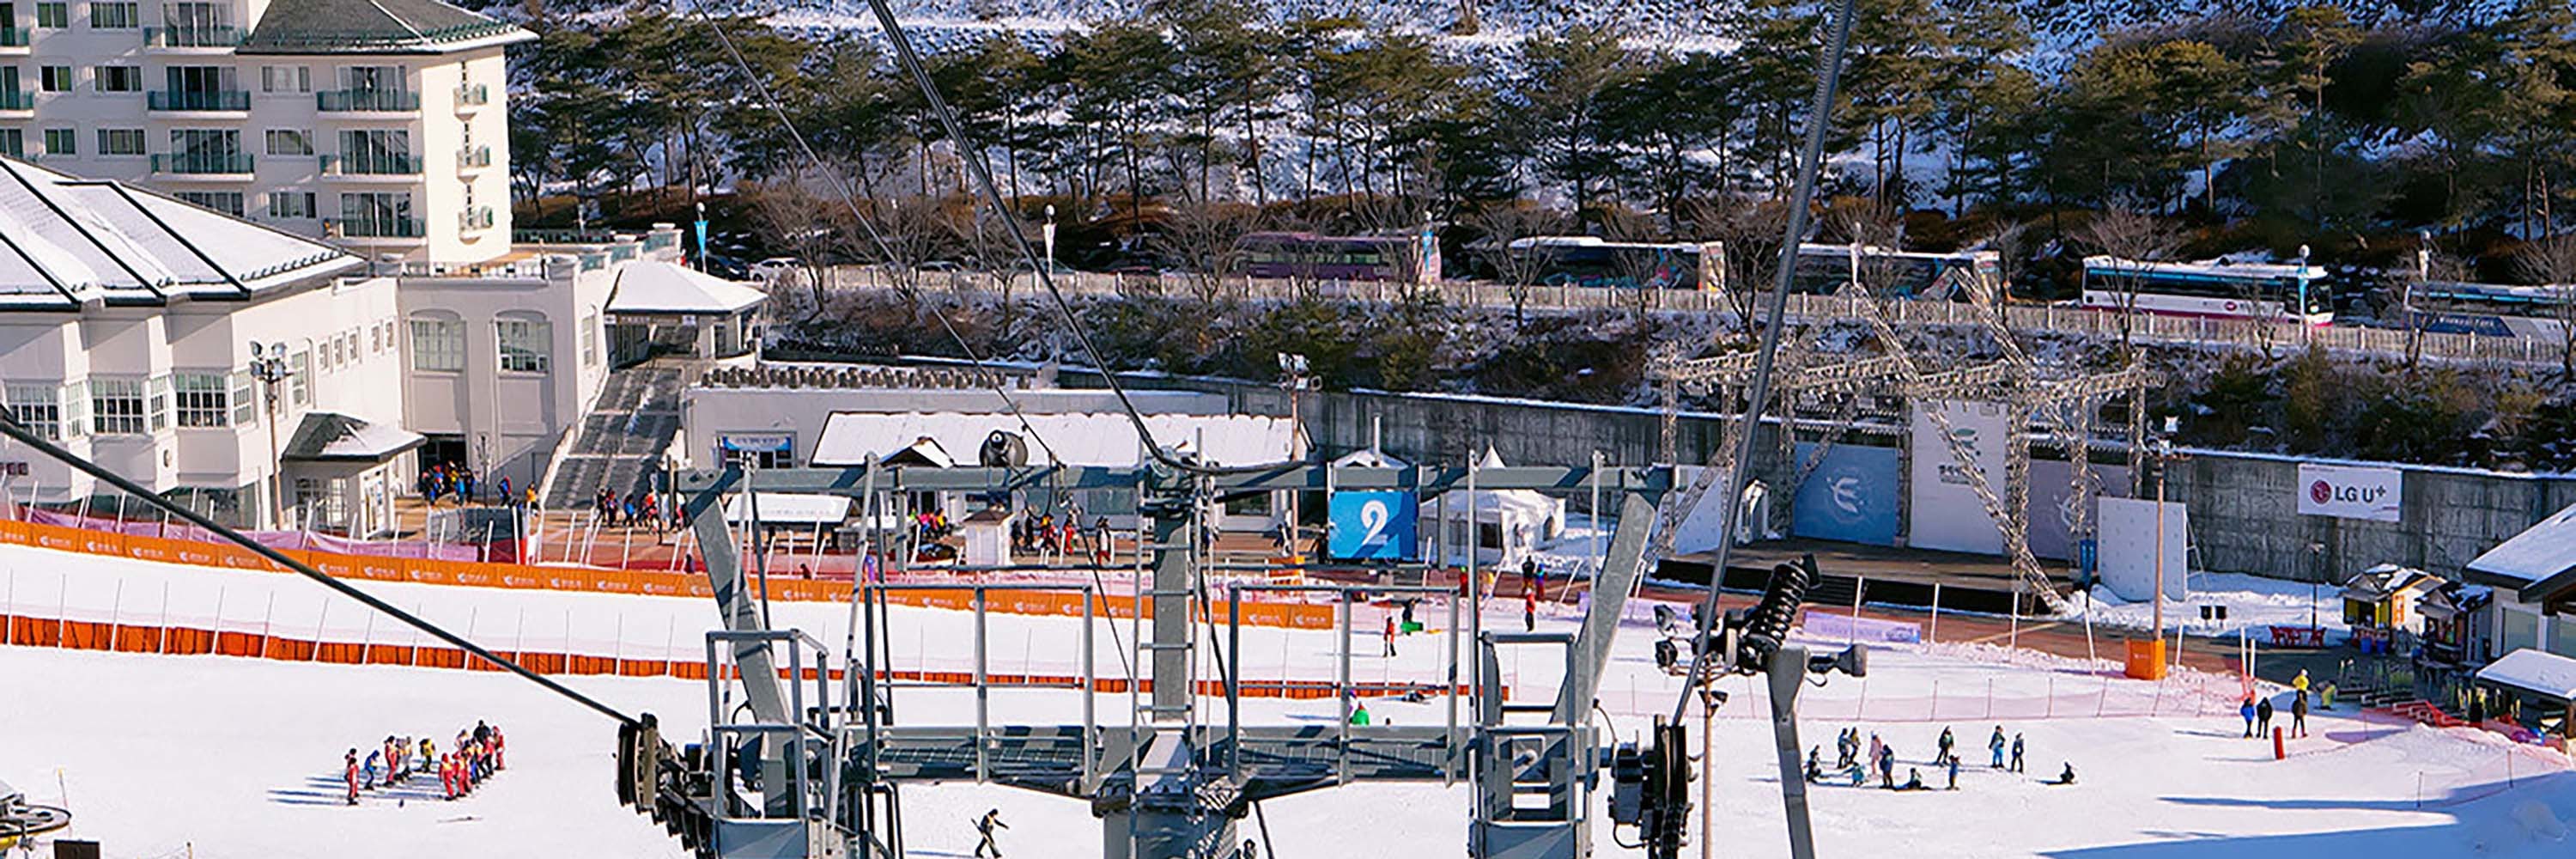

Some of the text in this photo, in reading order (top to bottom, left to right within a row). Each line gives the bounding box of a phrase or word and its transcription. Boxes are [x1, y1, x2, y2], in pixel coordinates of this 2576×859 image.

[2335, 484, 2386, 503] LG U+
[1360, 499, 1388, 545] 2
